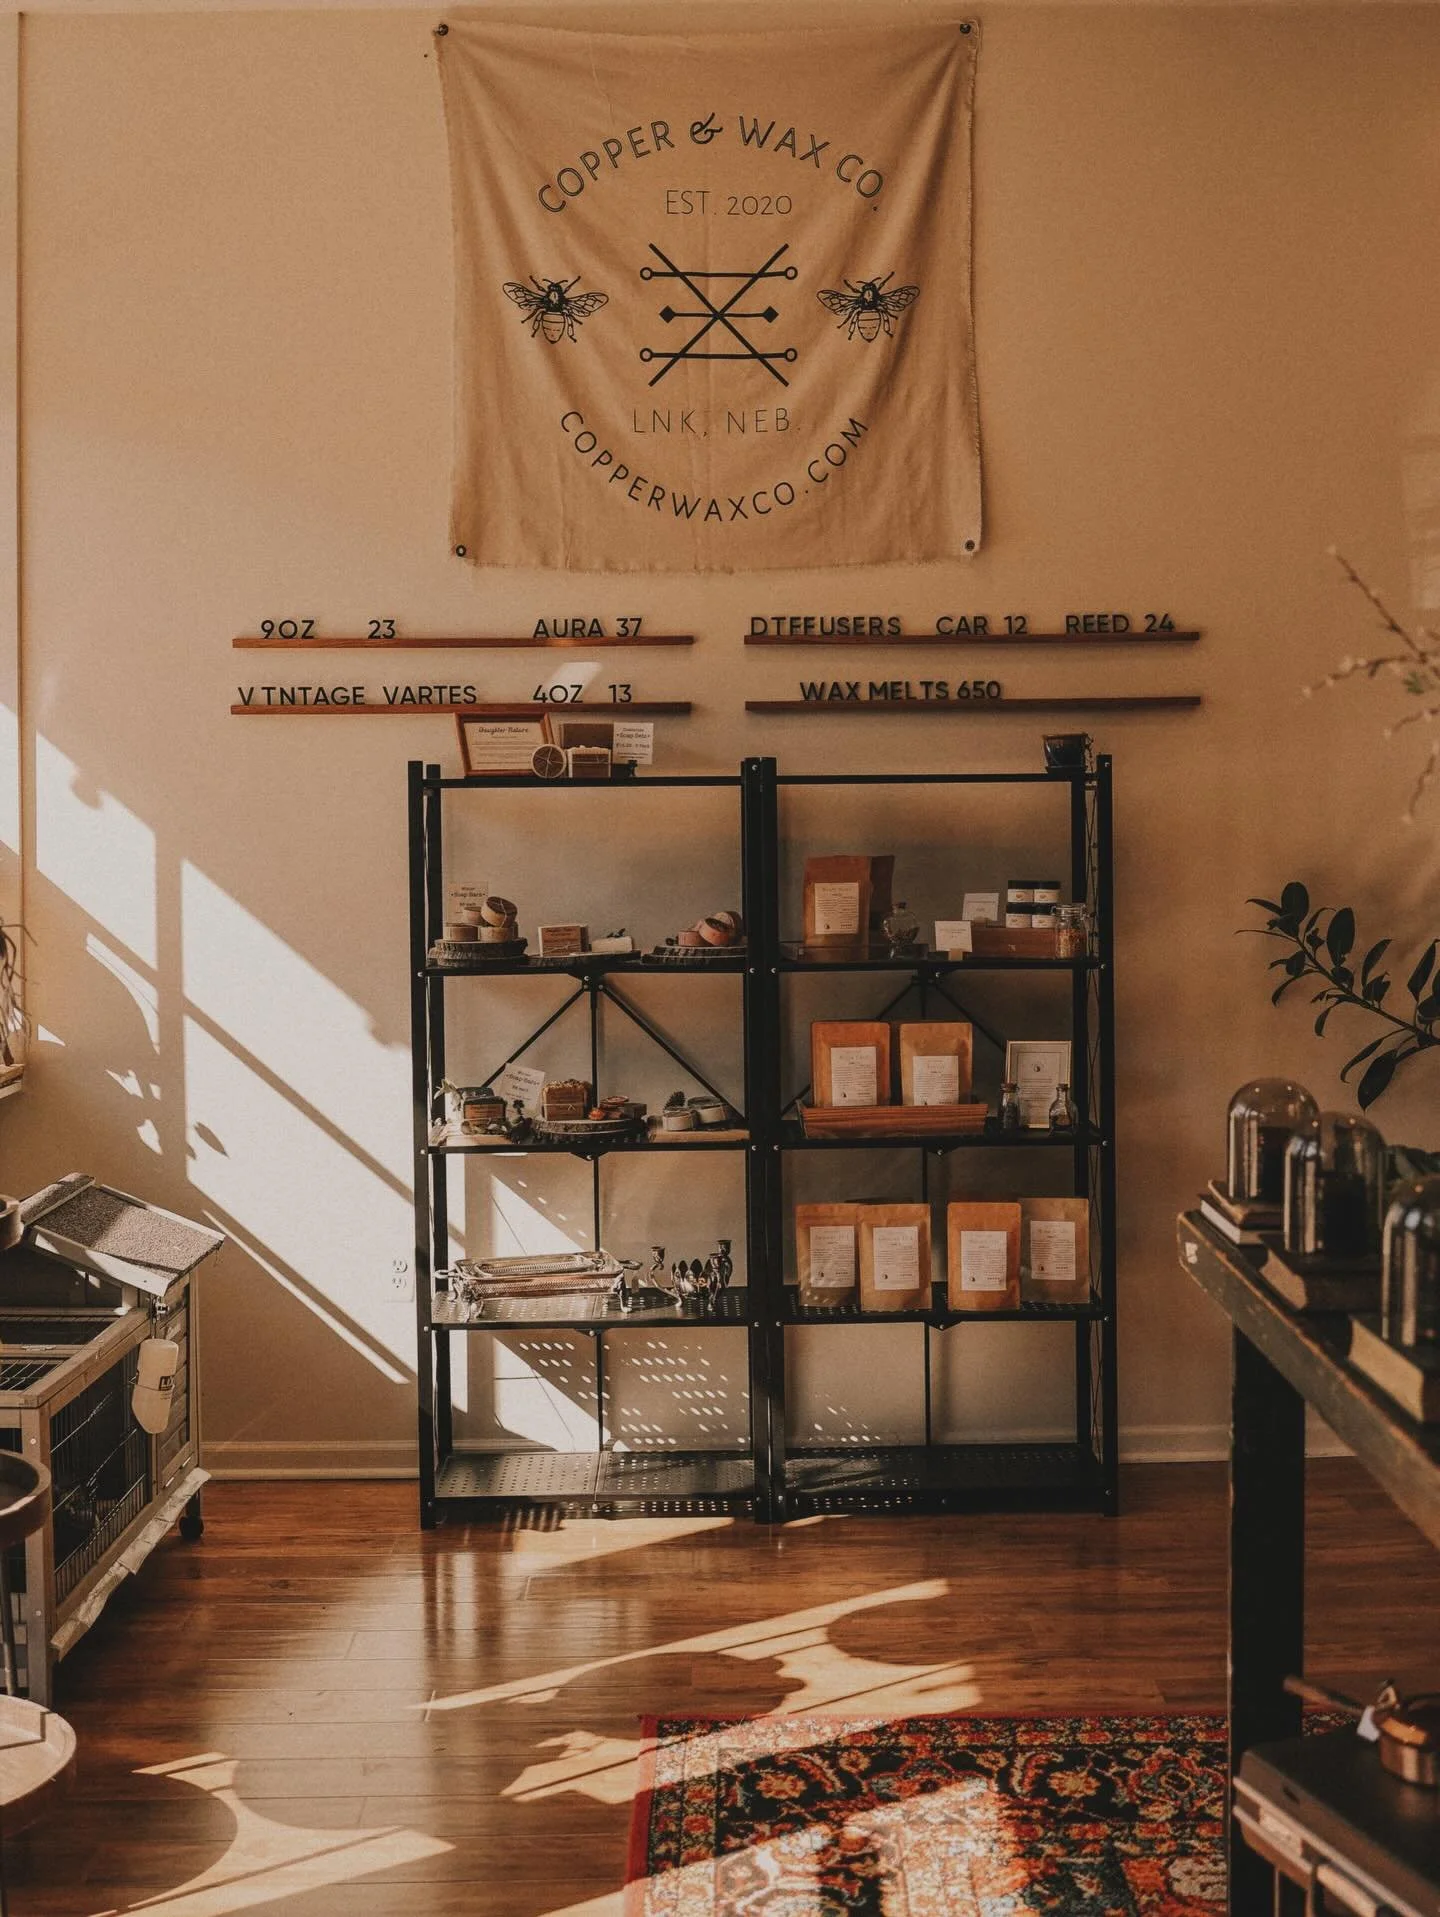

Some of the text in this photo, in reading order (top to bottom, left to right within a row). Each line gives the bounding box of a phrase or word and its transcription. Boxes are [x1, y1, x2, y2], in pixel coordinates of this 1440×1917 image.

[538, 112, 884, 213] COPPER & WAX CO.
[666, 189, 792, 215] EST. 2020
[633, 408, 707, 437] LNK,
[560, 410, 869, 522] COPPERWAXCO.COM
[367, 619, 396, 639] 23
[533, 618, 604, 638] AURA
[616, 617, 643, 637] 37
[935, 615, 989, 635] CAR
[1003, 615, 1028, 635] 12
[1065, 614, 1130, 634] REED
[1144, 613, 1175, 633] 24
[382, 685, 477, 704] VARTES
[607, 684, 632, 703] 13
[800, 680, 1001, 701] WAX MELTS 650
